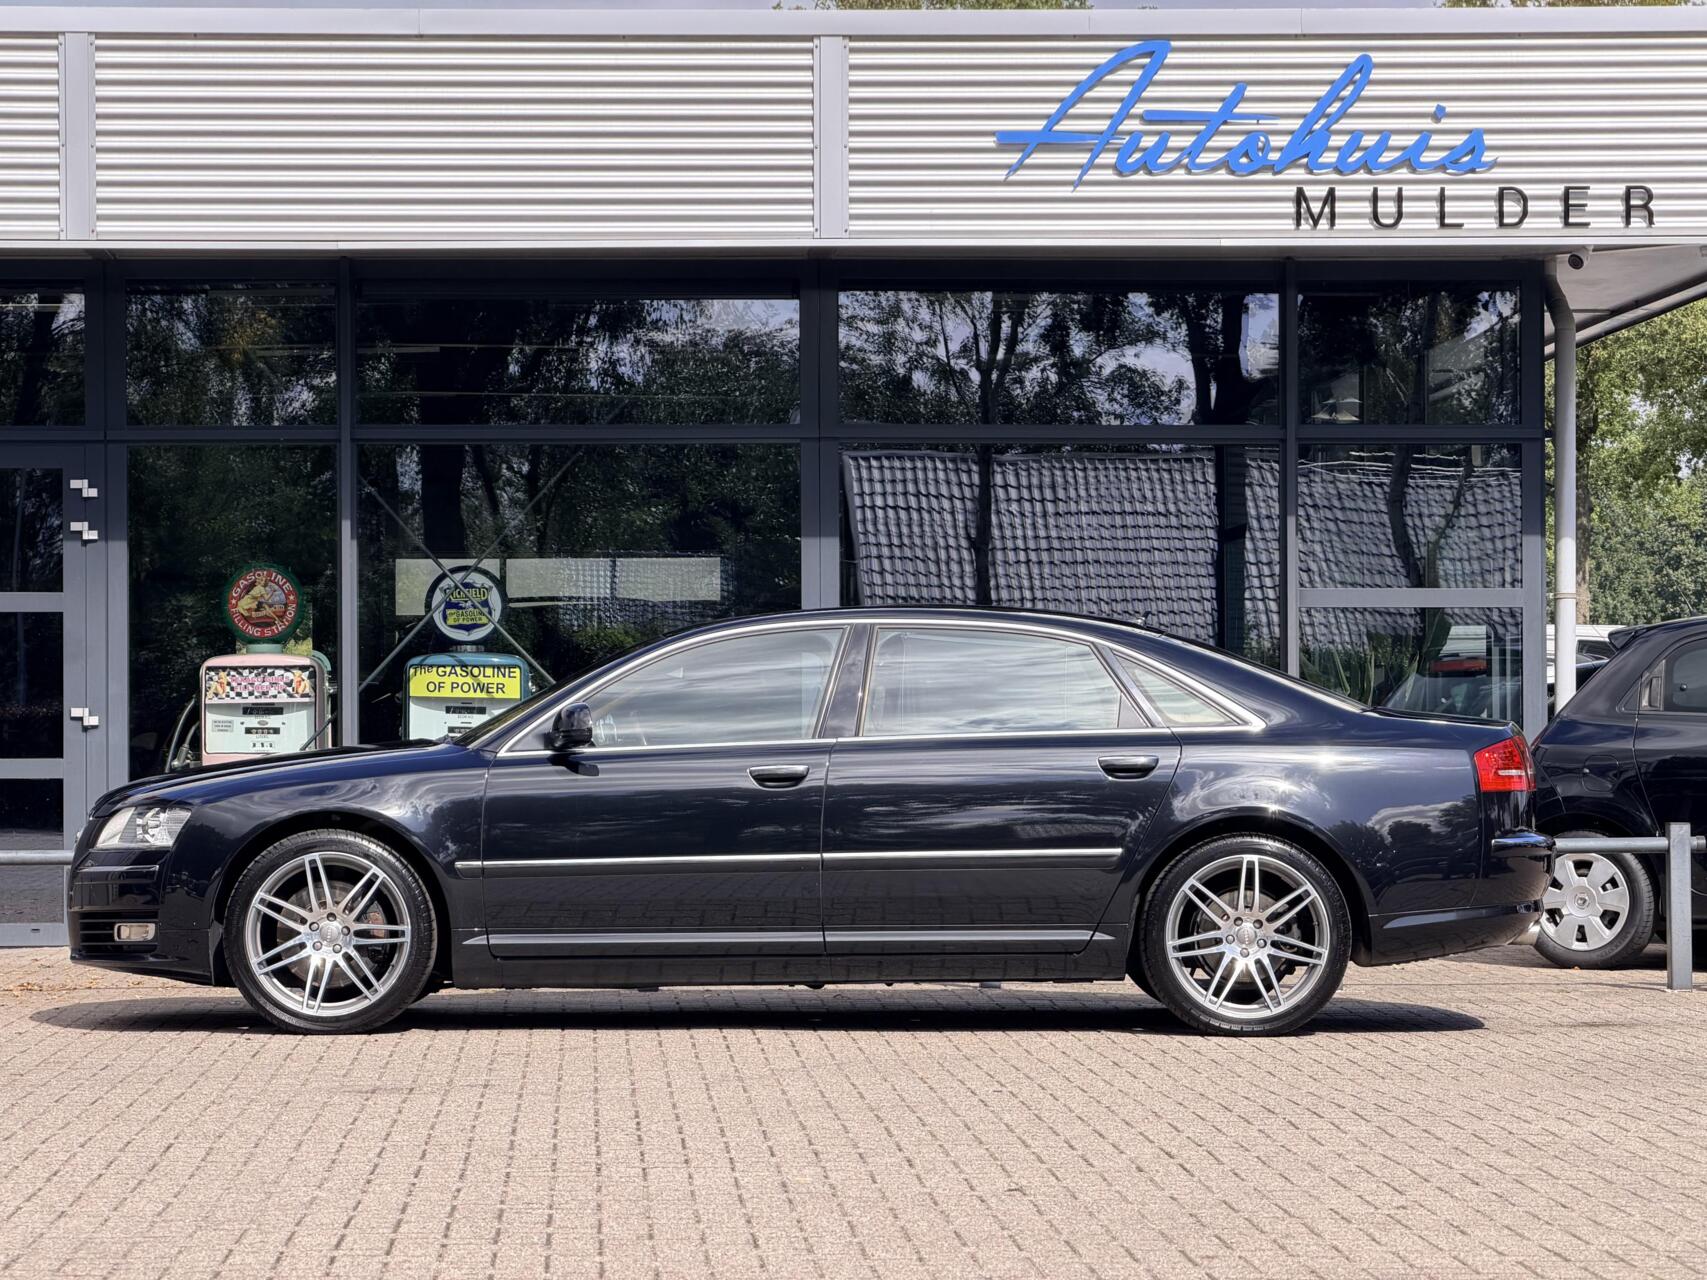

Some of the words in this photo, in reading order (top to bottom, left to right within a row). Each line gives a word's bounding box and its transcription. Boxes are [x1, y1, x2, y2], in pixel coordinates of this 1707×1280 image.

[995, 40, 1498, 192] Autohuis
[1295, 184, 1656, 230] MULDER
[230, 608, 261, 636] FILLING
[264, 603, 297, 636] STATION
[412, 666, 433, 677] The
[436, 666, 517, 679] GASOLINE
[426, 681, 445, 694] OF
[451, 682, 506, 694] POWER
